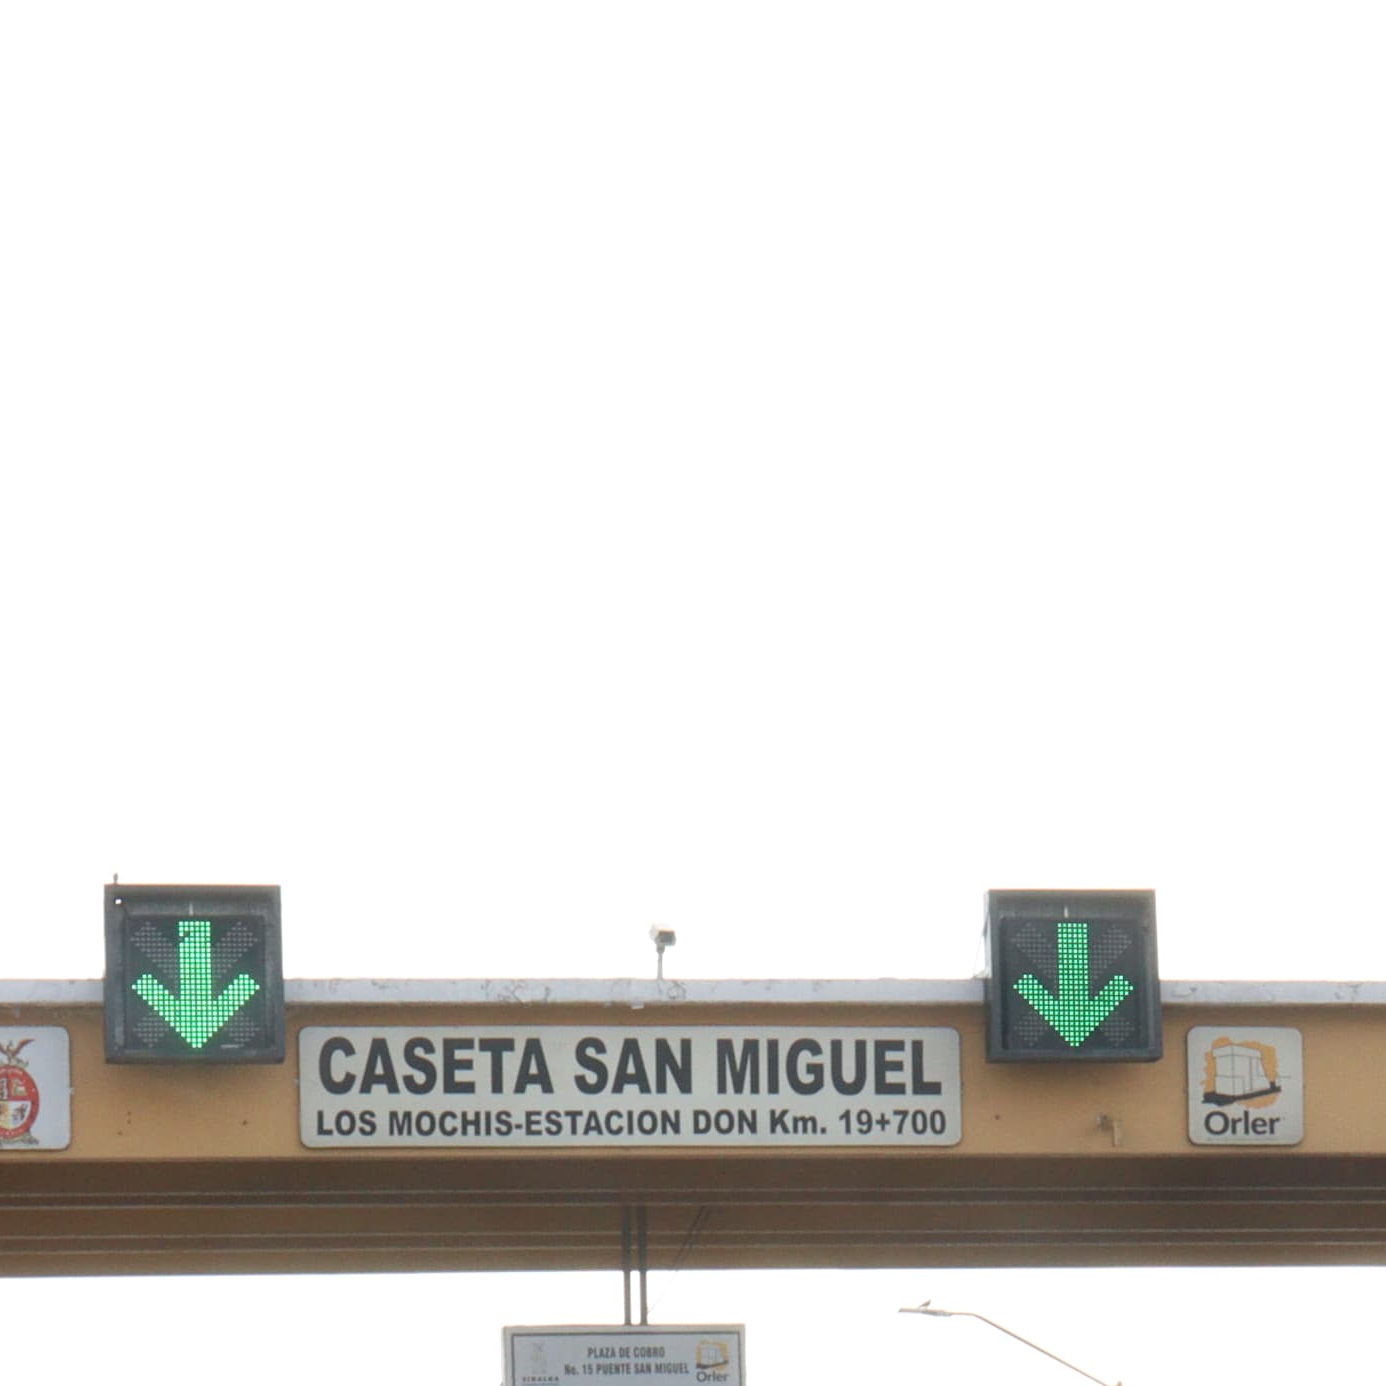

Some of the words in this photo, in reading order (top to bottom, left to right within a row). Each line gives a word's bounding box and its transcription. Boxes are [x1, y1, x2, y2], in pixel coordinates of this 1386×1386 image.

[318, 1036, 555, 1095] CASETA
[574, 1036, 693, 1095] SAN
[716, 1037, 942, 1096] MIGUEL
[316, 1109, 377, 1136] LOS
[388, 1109, 681, 1136] MOCHIS-ESTACION
[692, 1109, 758, 1135] DON
[769, 1109, 828, 1135] Km.
[838, 1109, 946, 1135] 19+700
[1203, 1109, 1281, 1136] Orler
[587, 1346, 616, 1359] PLAZA
[619, 1346, 631, 1358] DE
[633, 1346, 665, 1358] COBRO
[564, 1363, 580, 1376] No.
[582, 1363, 593, 1375] 15
[596, 1363, 631, 1375] PUENTE
[634, 1363, 652, 1374] SAN
[654, 1362, 689, 1374] MIGUEL
[696, 1371, 729, 1383] Orler
